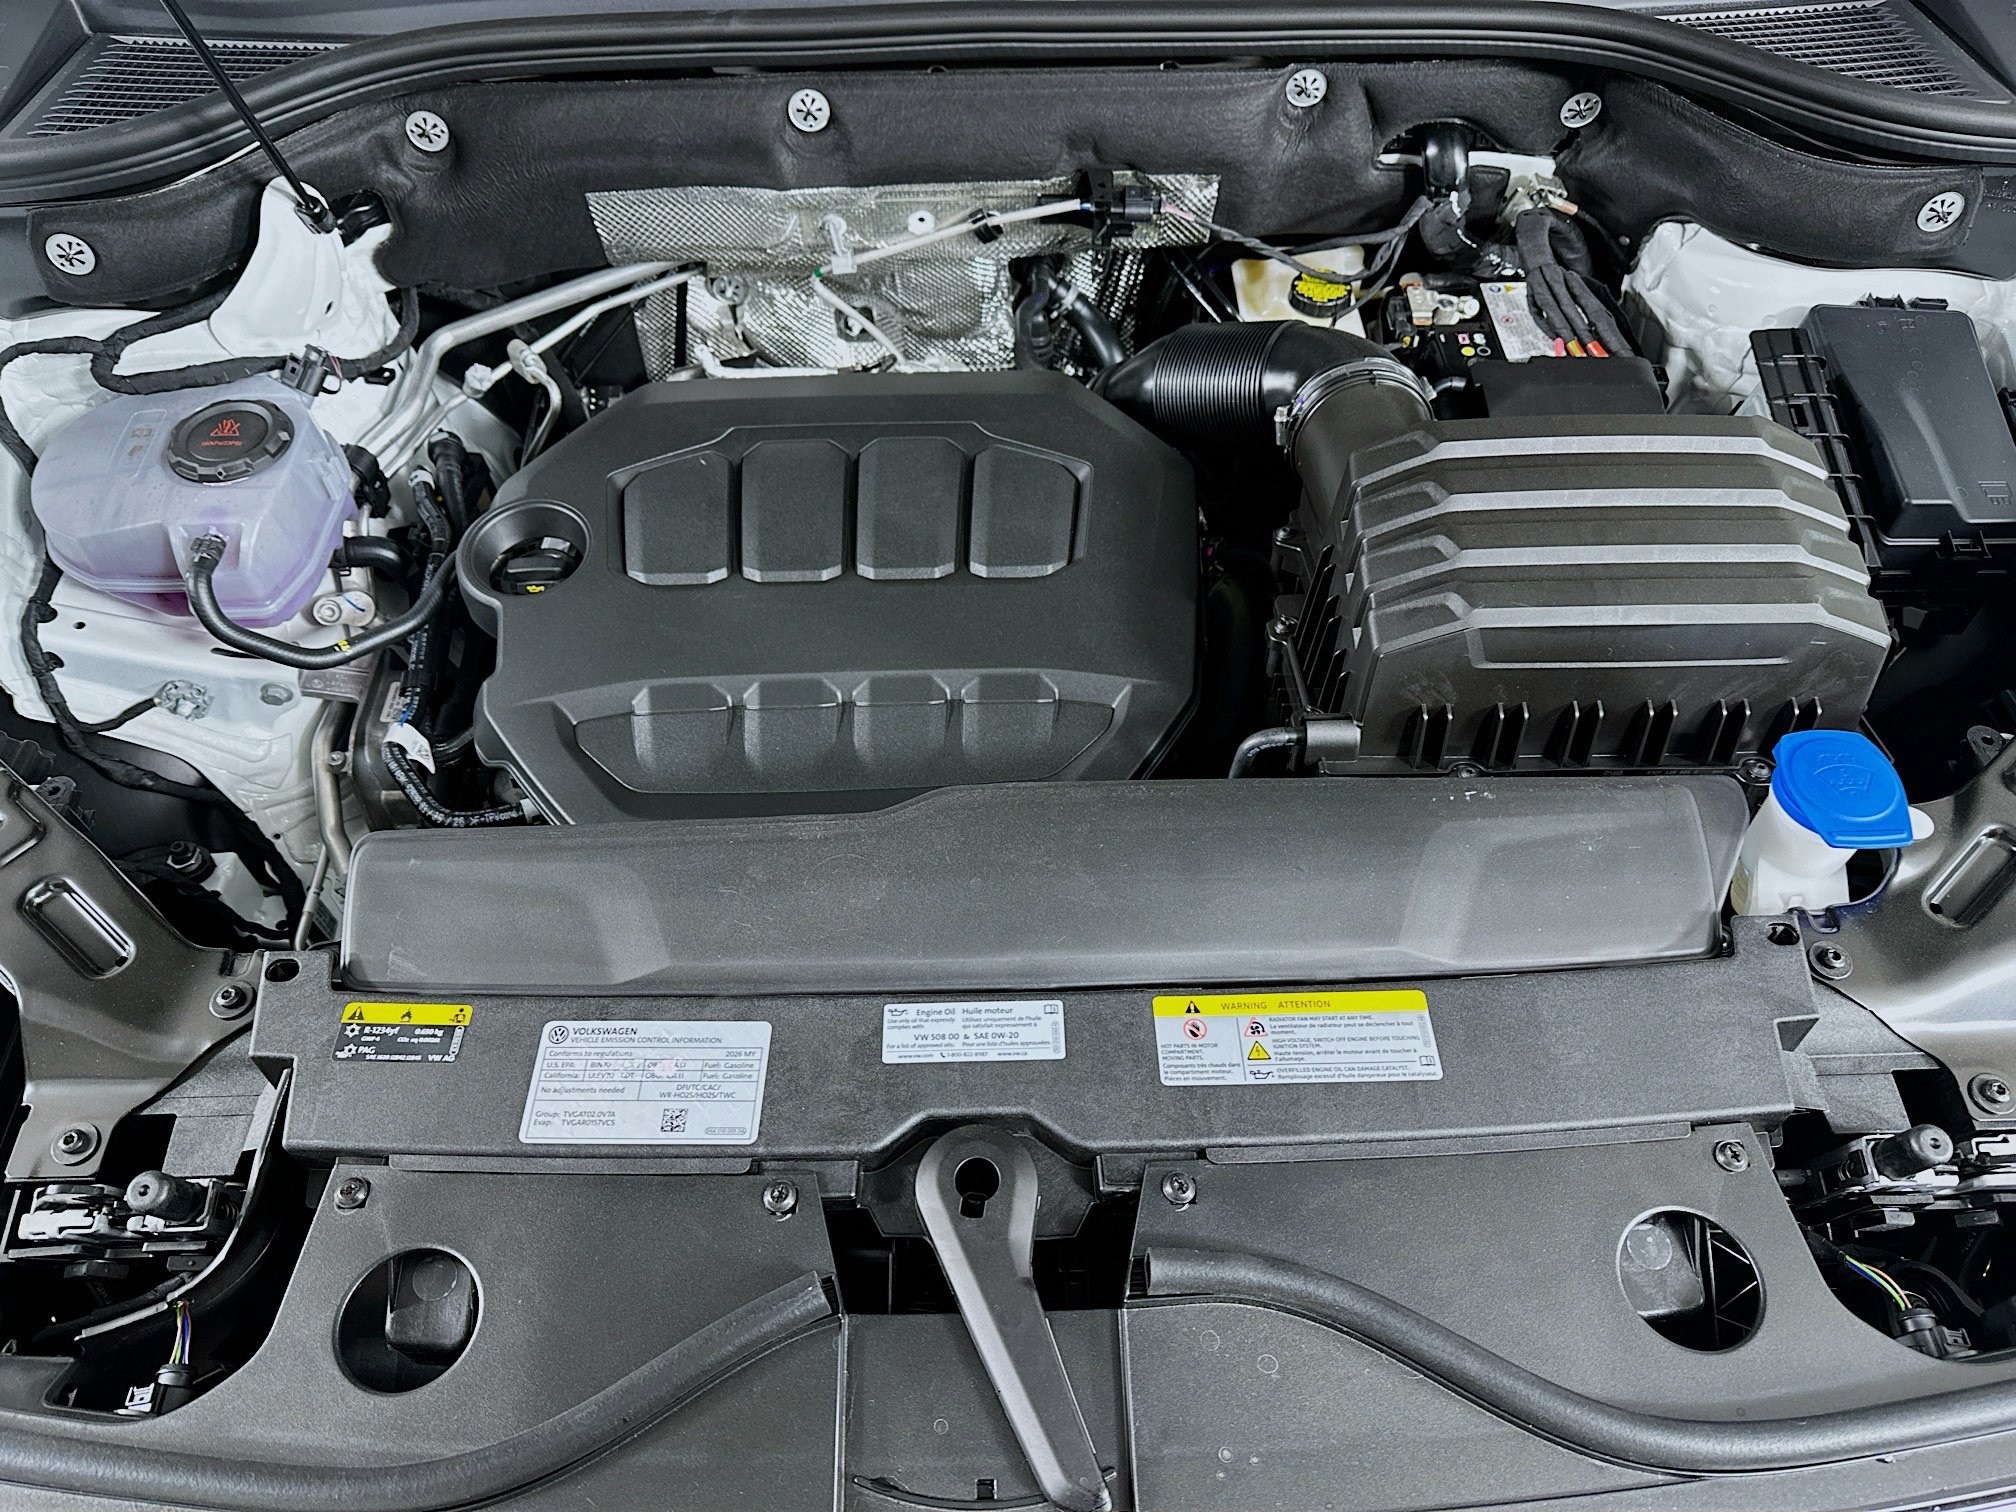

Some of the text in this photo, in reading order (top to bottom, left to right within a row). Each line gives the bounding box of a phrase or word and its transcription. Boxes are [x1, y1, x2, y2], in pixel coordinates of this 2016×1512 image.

[1221, 1000, 1331, 1010] WARNING ATTENTION
[916, 1009, 943, 1017] Engine
[962, 1007, 983, 1015] Huile
[363, 1026, 400, 1036] R-1234yf
[572, 1027, 638, 1035] VOLKSWAGEN
[973, 1032, 989, 1040] SAE
[991, 1031, 1019, 1039] 0W-20
[358, 1046, 376, 1054] PAG
[552, 1087, 597, 1095] adjustments
